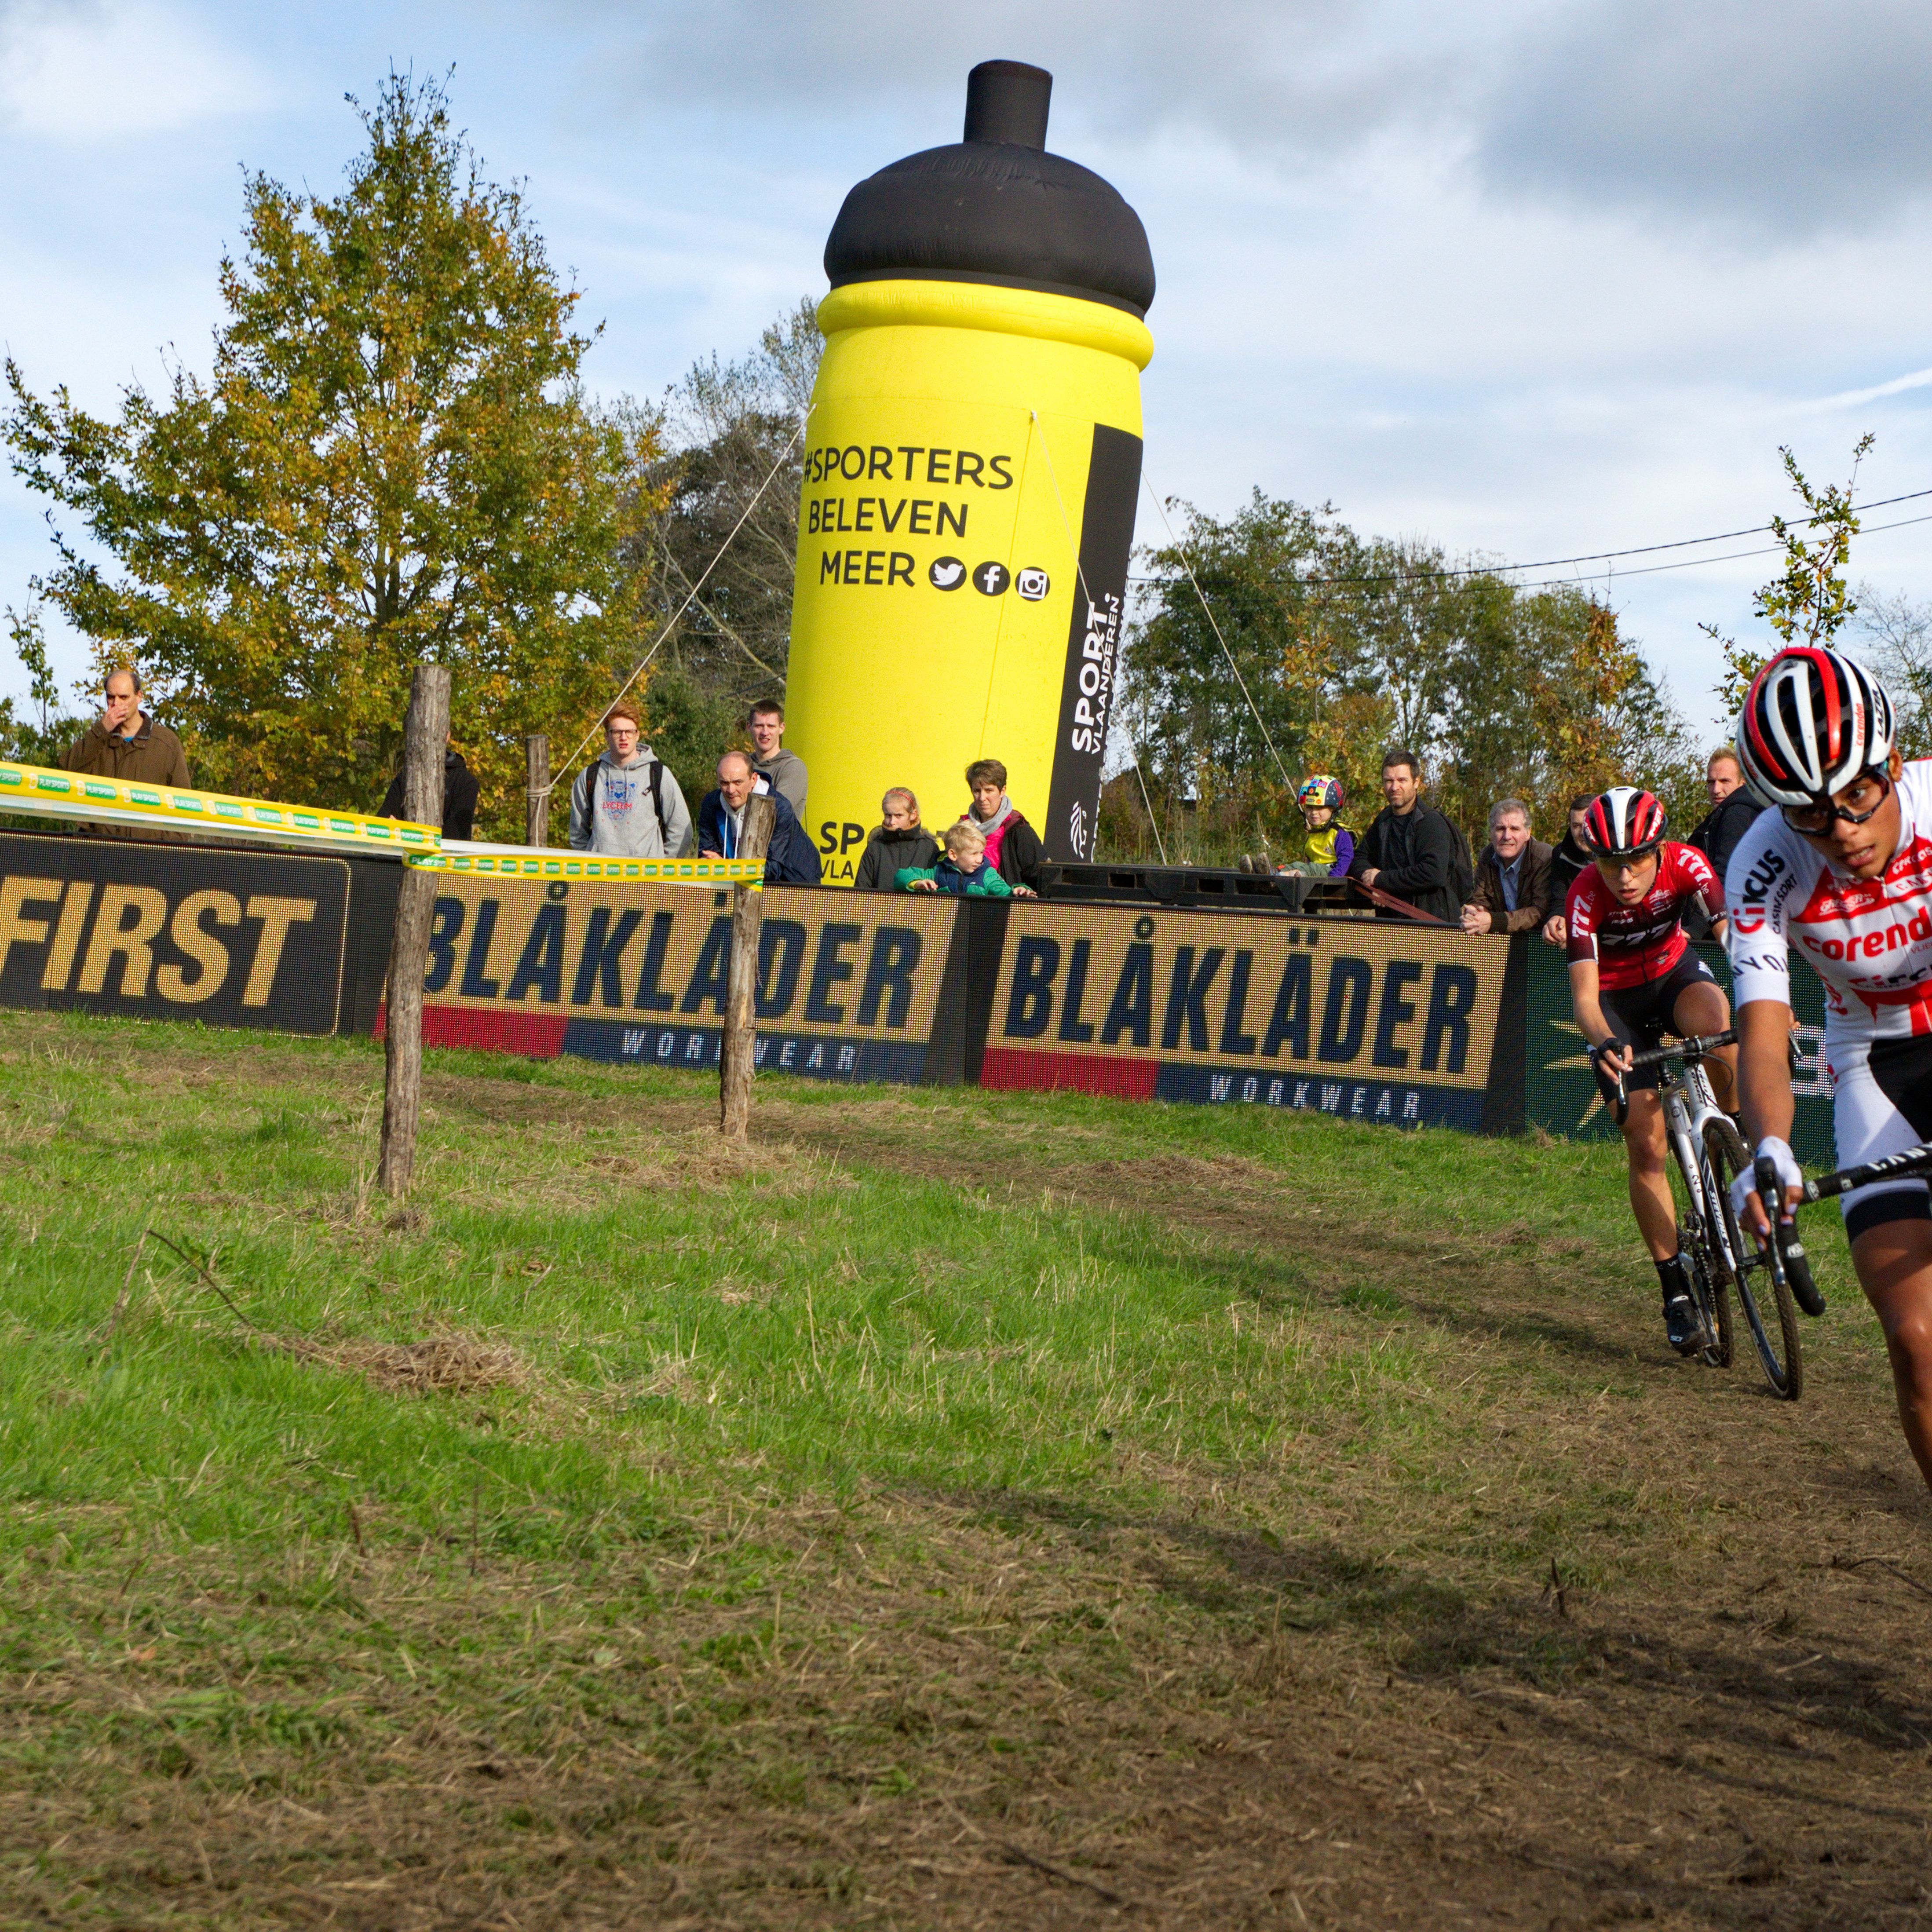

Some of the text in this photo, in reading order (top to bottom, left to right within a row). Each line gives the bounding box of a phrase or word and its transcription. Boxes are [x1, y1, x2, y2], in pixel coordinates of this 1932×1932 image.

[804, 446, 1013, 490] #SPORTERS
[808, 498, 968, 538] BELEVEN
[820, 550, 915, 587] MEER
[1091, 595, 1120, 755] VLAANDEREN
[820, 821, 865, 855] SP
[0, 875, 317, 1007] FIRST
[1004, 915, 1477, 1073] BLÅKLÄDER
[621, 1029, 856, 1070] WORWEAR
[1211, 1075, 1420, 1119] WORKWEAR
